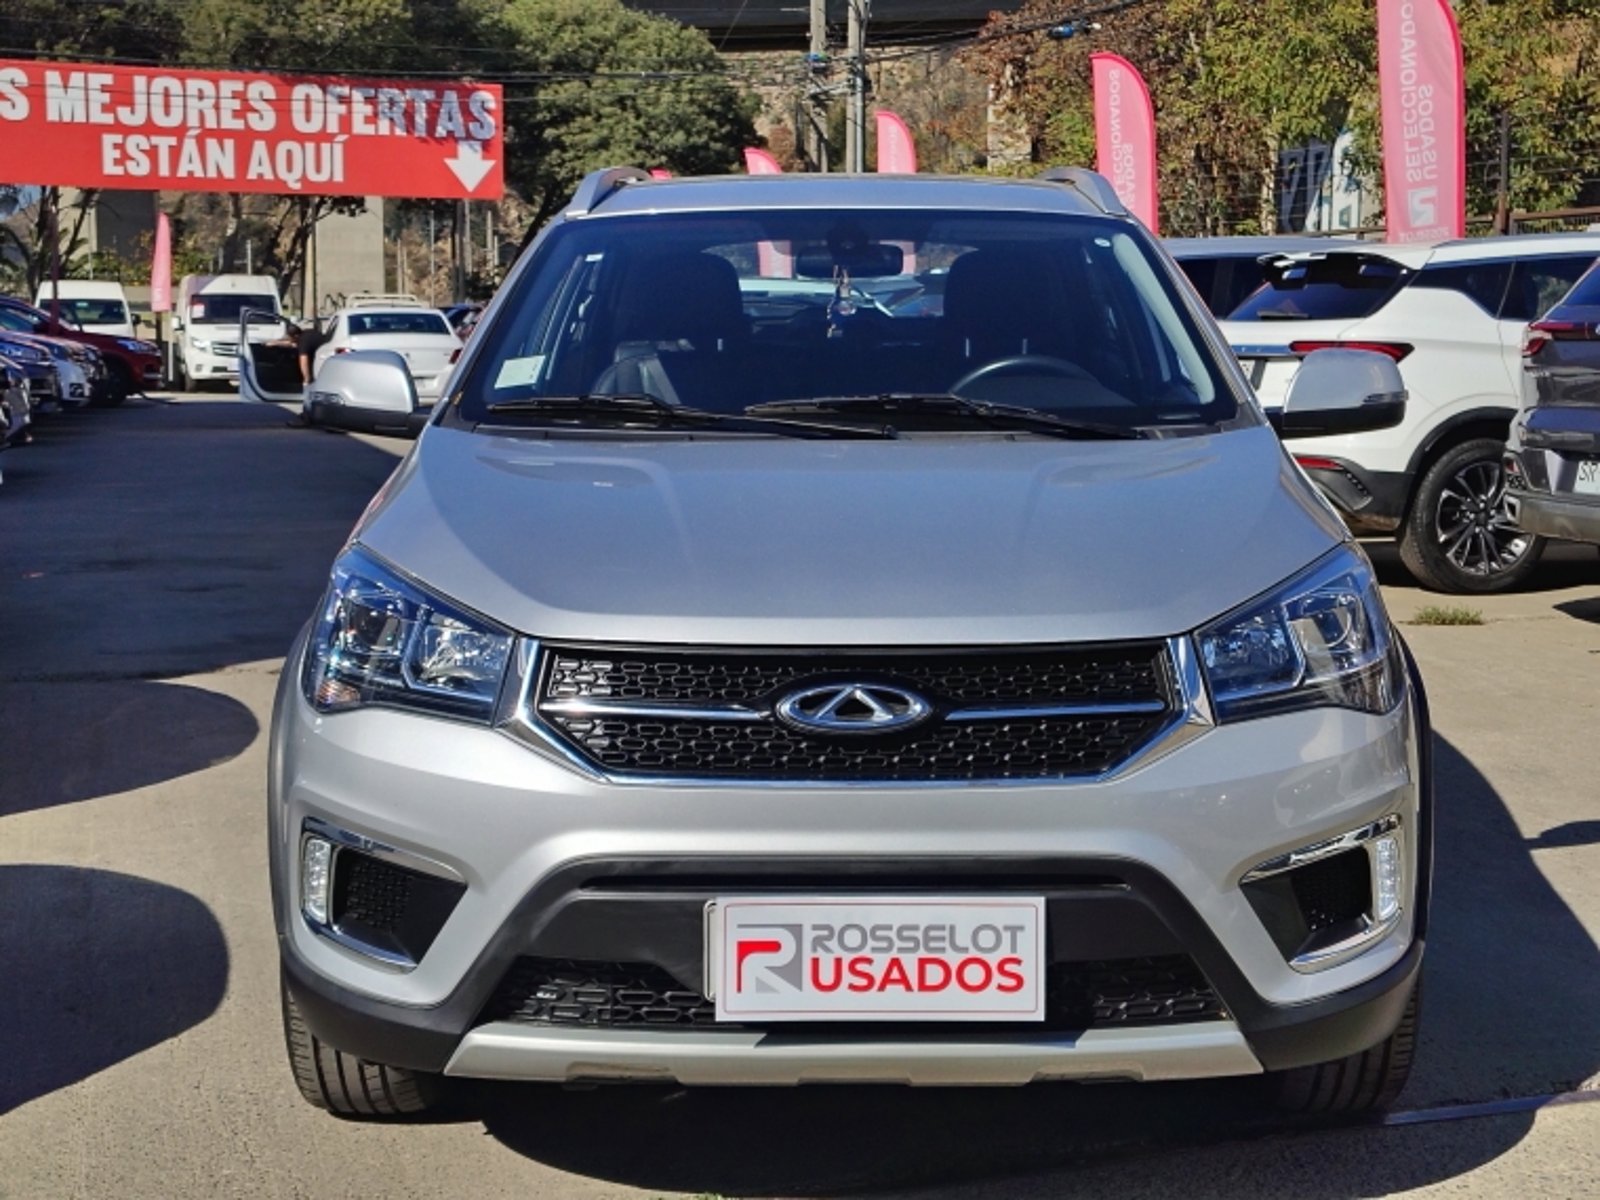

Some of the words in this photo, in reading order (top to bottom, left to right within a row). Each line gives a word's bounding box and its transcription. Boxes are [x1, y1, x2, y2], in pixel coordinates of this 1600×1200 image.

[45, 69, 277, 132] MEJORES
[291, 83, 497, 140] OFERTAS
[101, 129, 236, 180] ESTÁN
[246, 135, 350, 189] AQUÍ
[810, 923, 1026, 954] ROSSELOT
[810, 956, 1025, 993] USADOS
